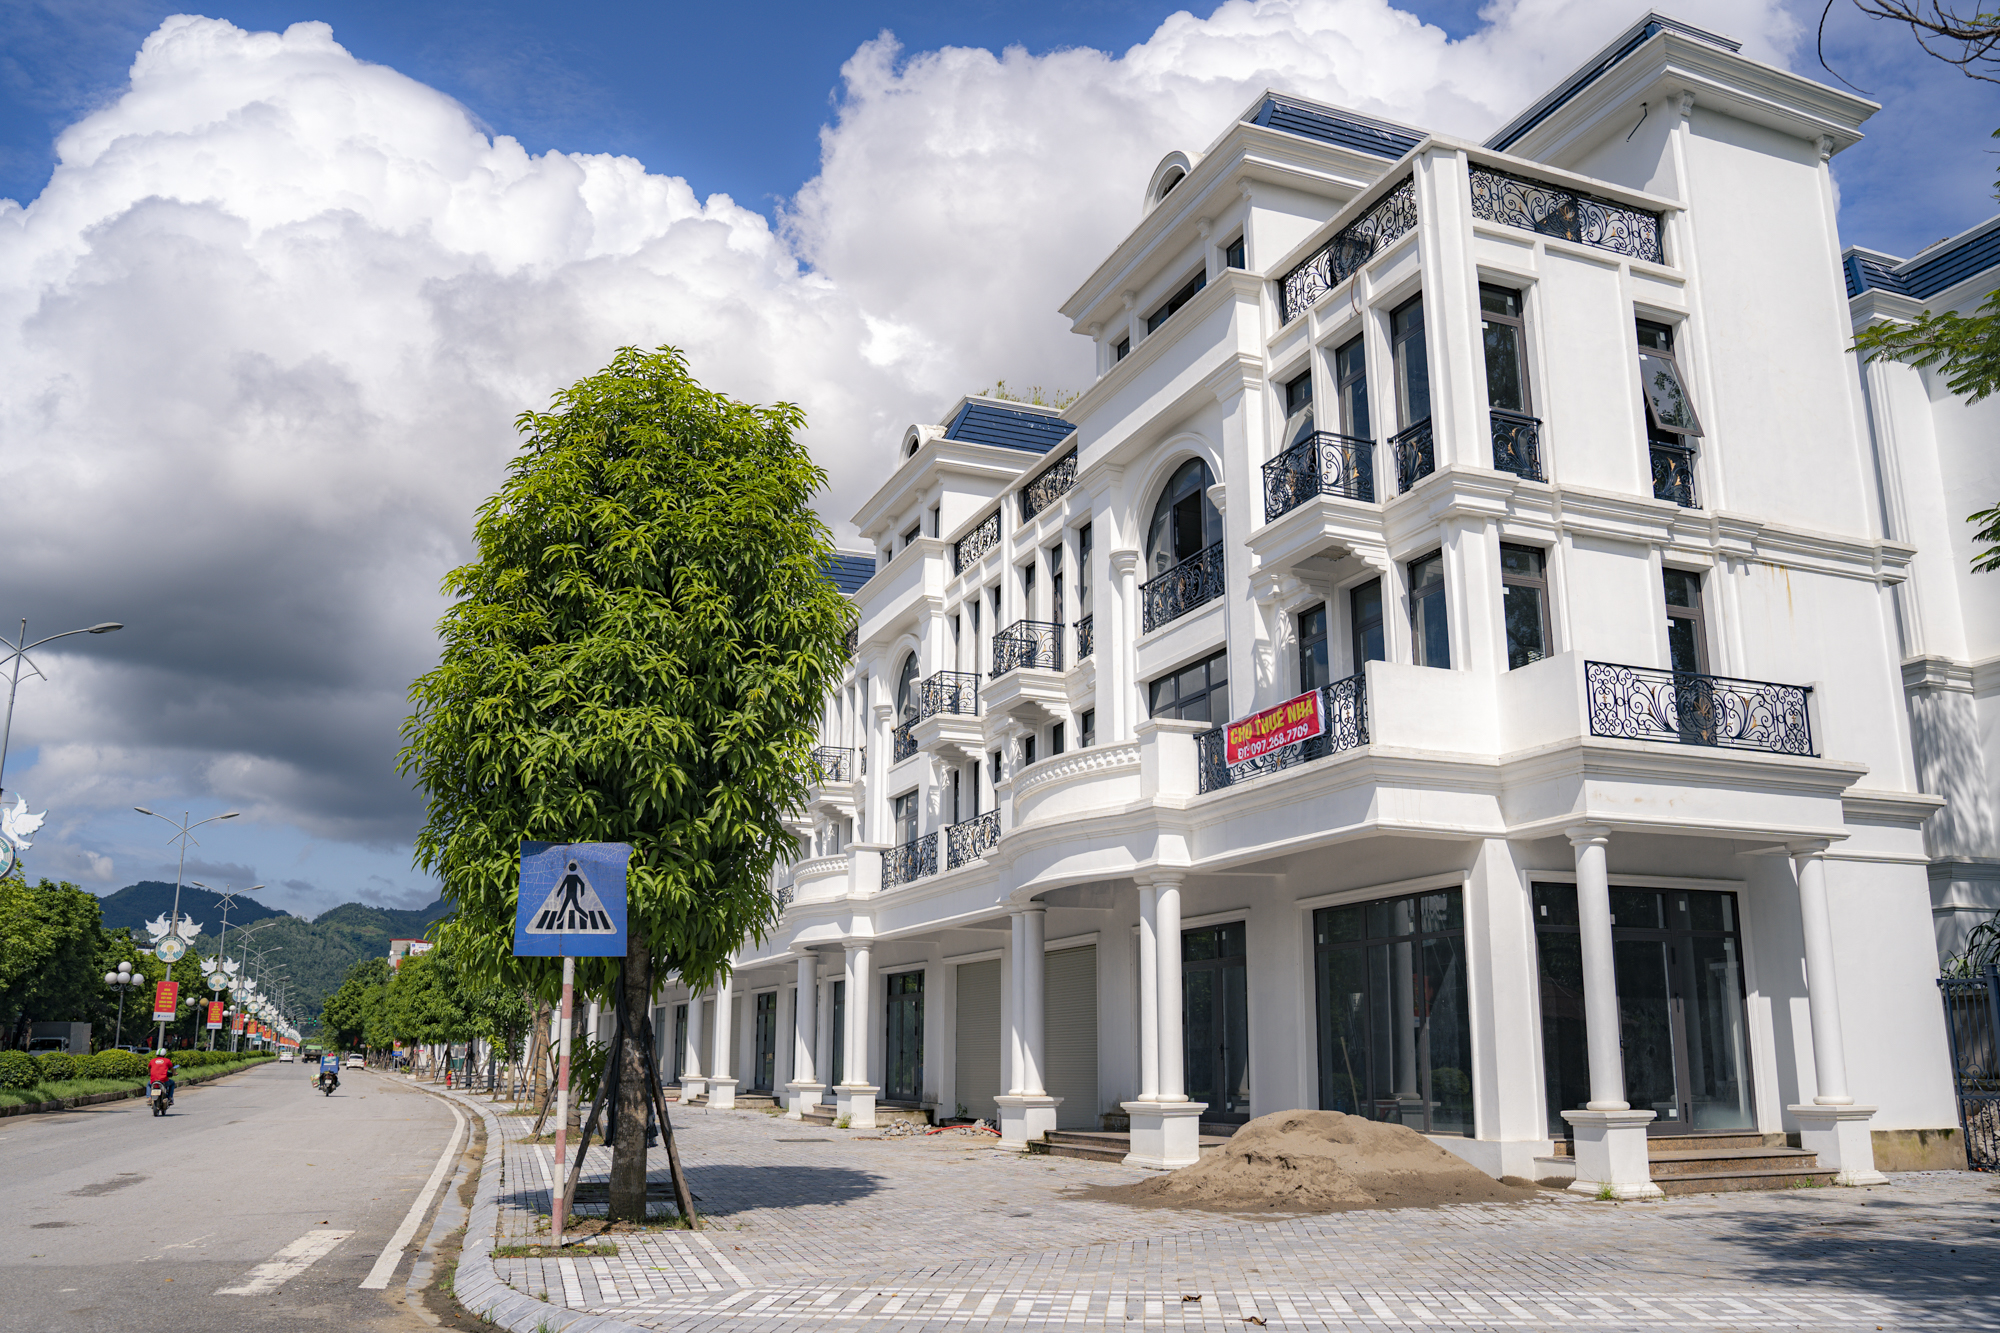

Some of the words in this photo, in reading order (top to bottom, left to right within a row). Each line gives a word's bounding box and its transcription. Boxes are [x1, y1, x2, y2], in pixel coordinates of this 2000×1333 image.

[1230, 723, 1253, 745] CHO
[1254, 708, 1285, 736] THUÊ
[1287, 695, 1314, 724] NHÀ
[1251, 722, 1309, 755] 097.268.7709
